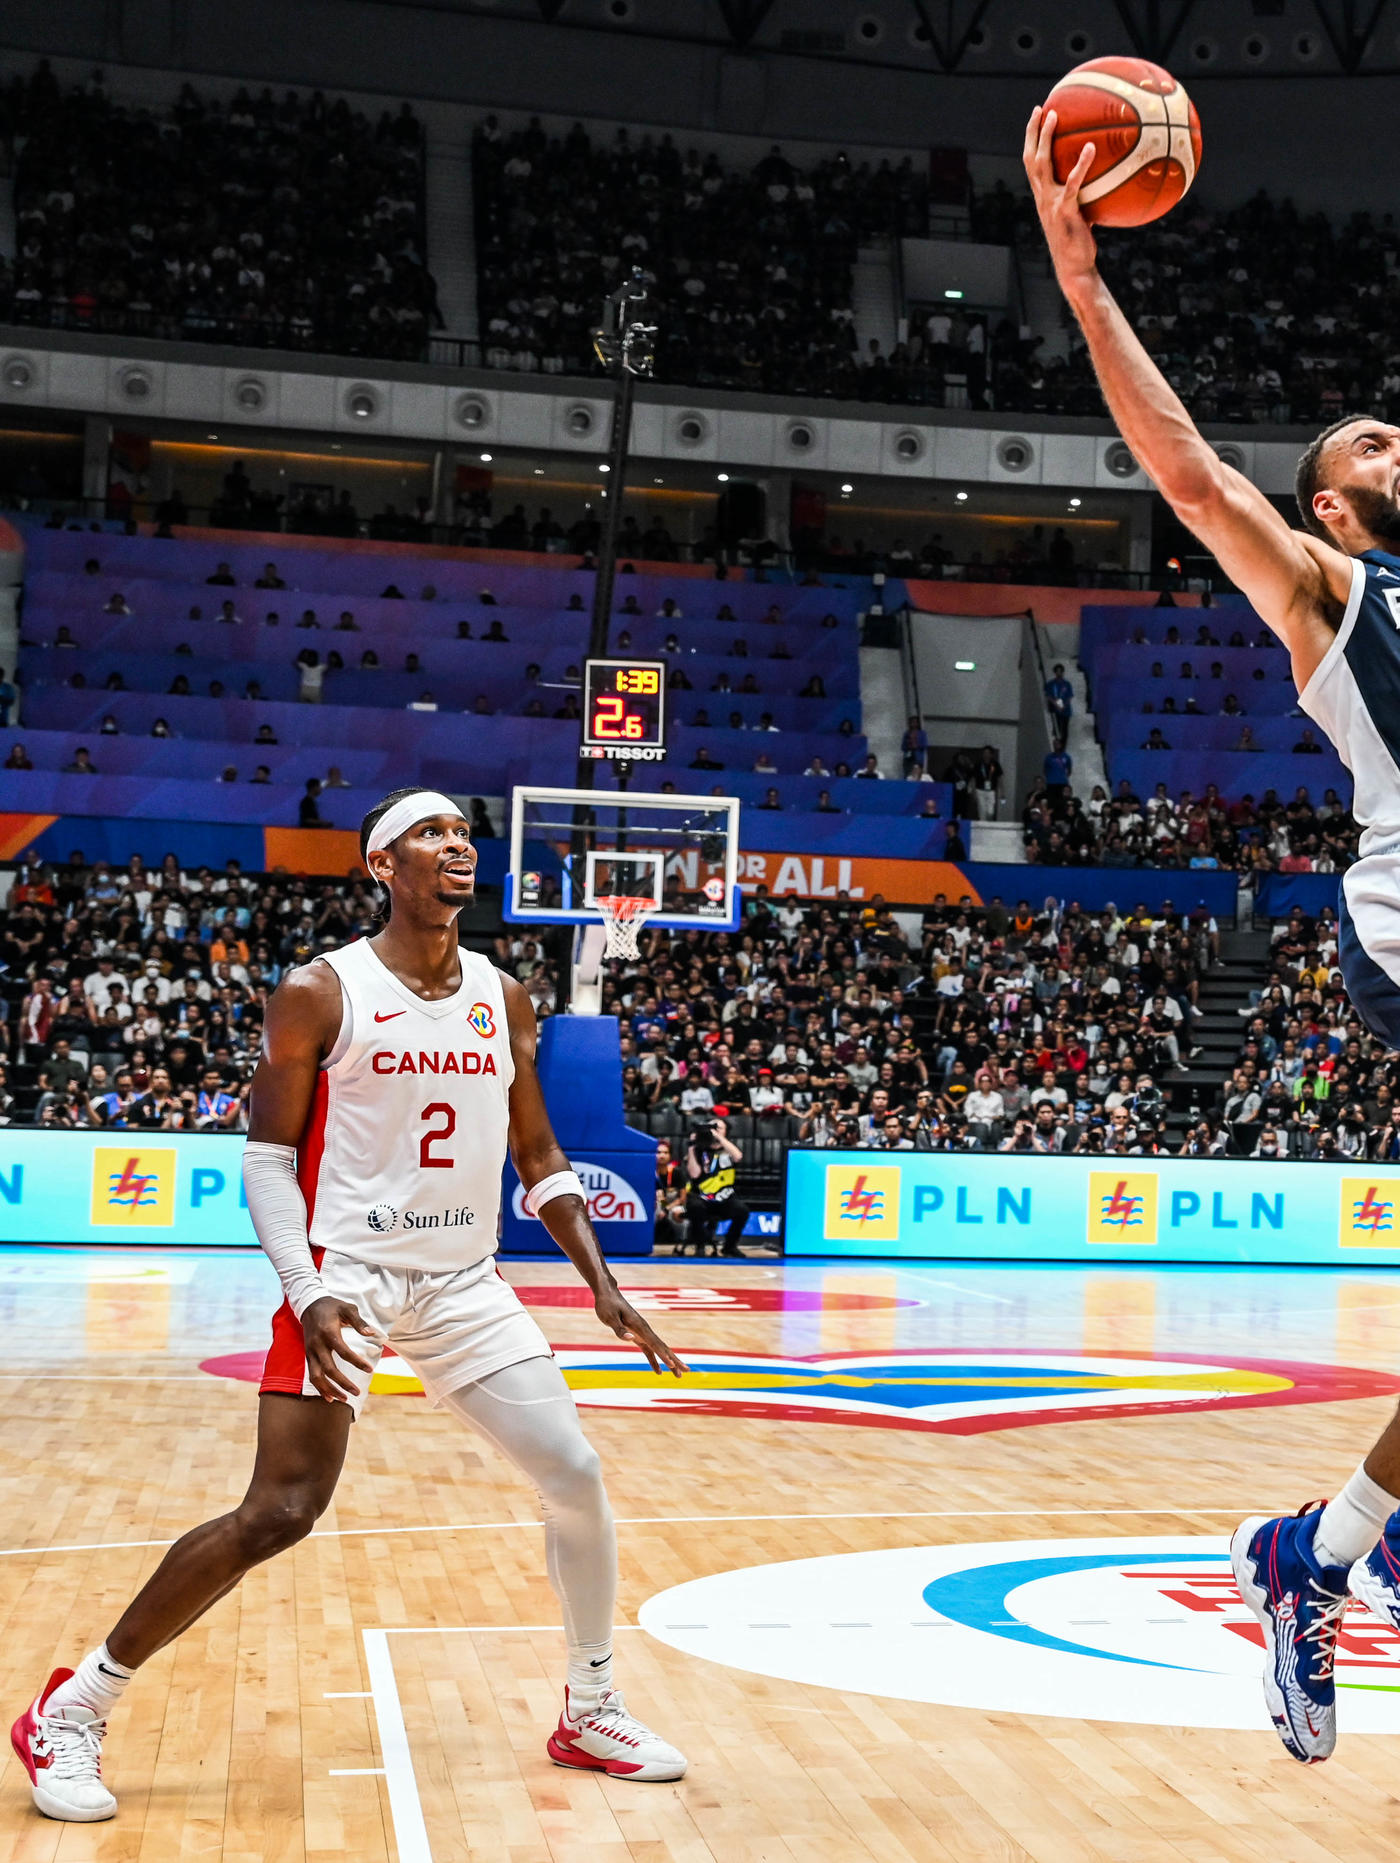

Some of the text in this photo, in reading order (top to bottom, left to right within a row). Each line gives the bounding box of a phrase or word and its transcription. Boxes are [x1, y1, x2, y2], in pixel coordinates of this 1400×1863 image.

[616, 670, 659, 694] 1:39
[594, 696, 644, 739] 2.6
[604, 746, 667, 761] TISSOT
[772, 856, 865, 899] ALL
[372, 1051, 497, 1076] CANADA
[419, 1102, 456, 1168] 2
[402, 1206, 475, 1230] Sun Life
[913, 1185, 1032, 1225] PLN
[1170, 1190, 1285, 1230] PLN
